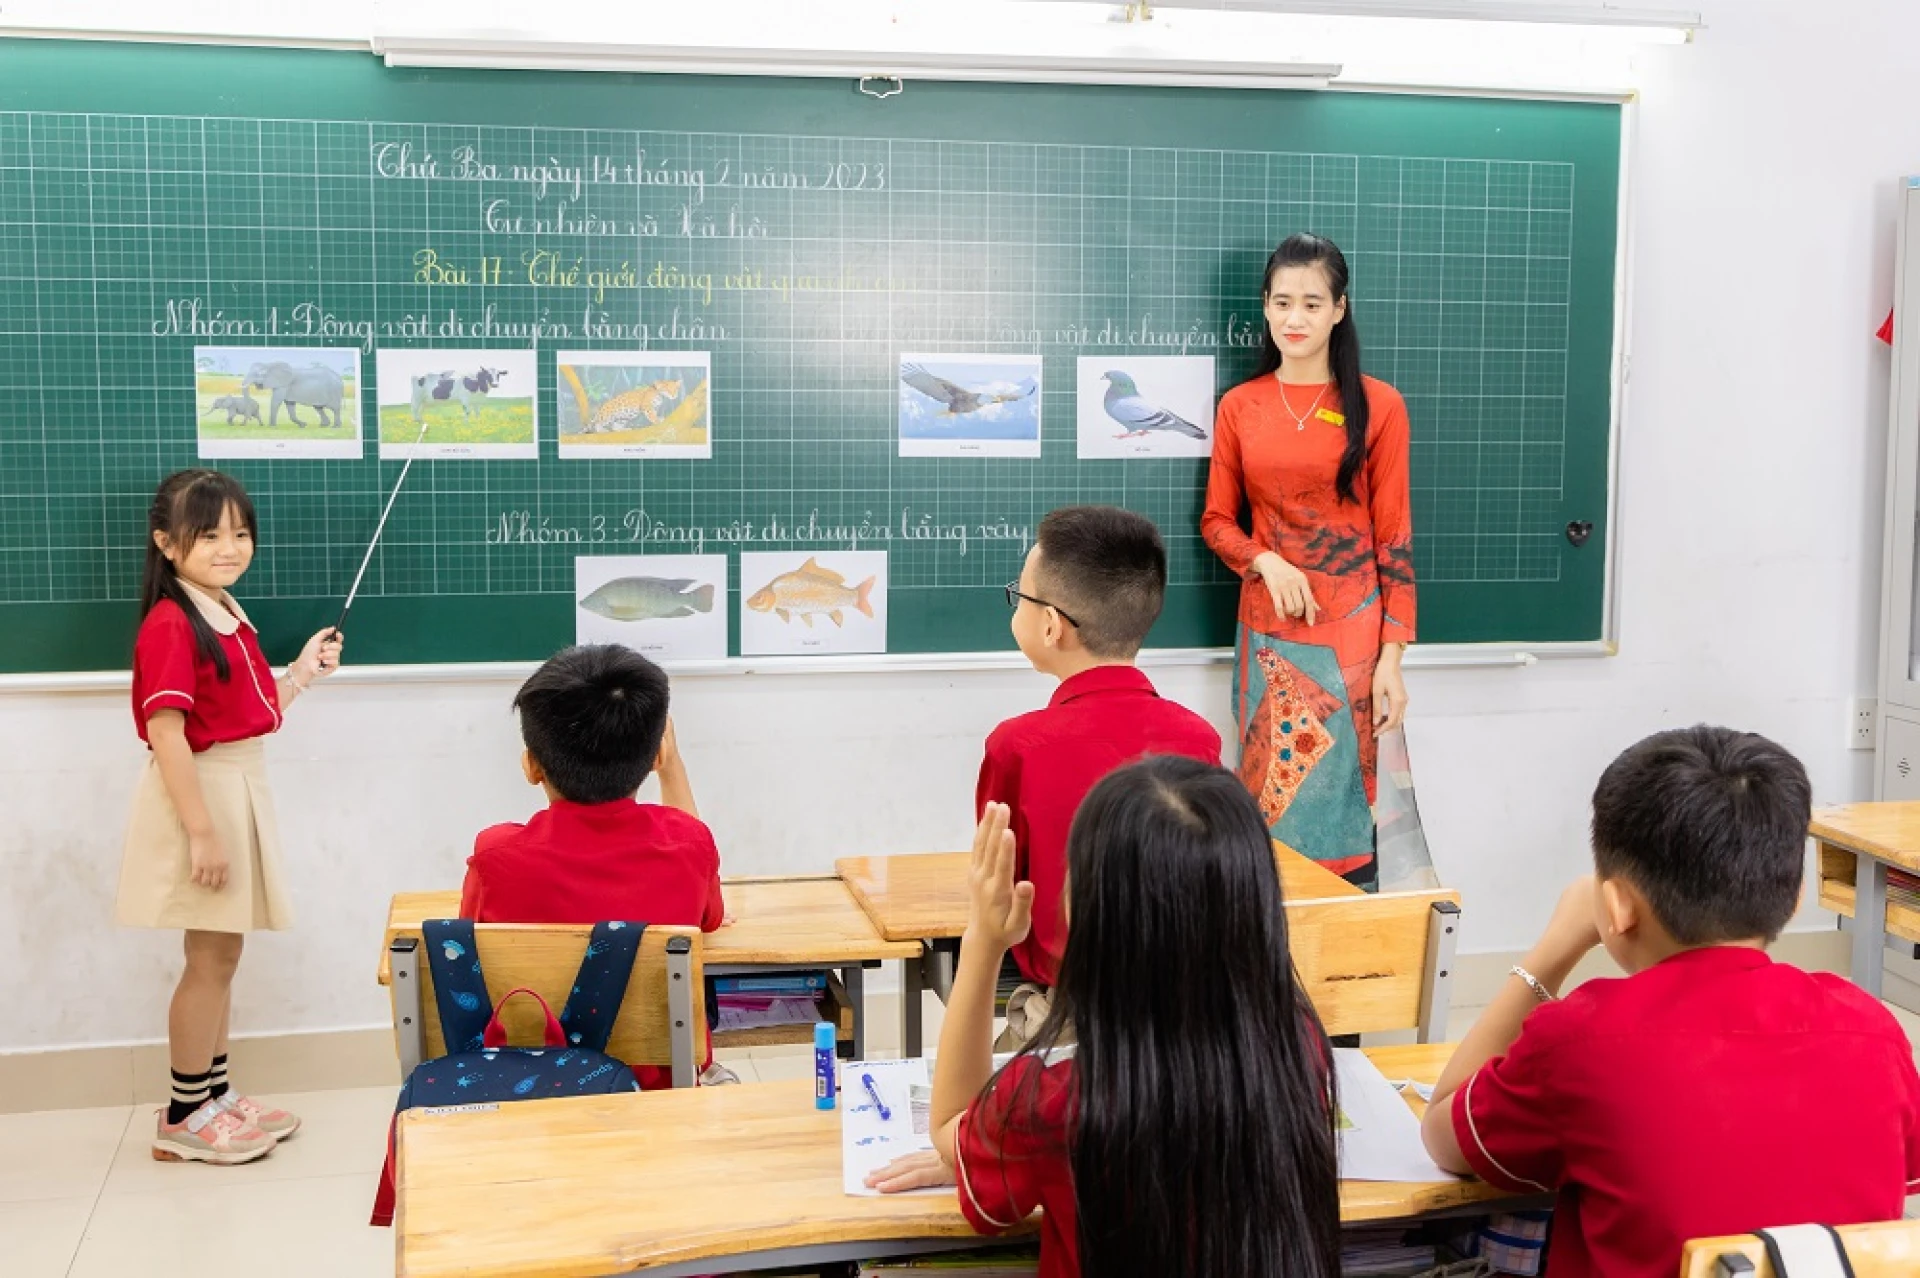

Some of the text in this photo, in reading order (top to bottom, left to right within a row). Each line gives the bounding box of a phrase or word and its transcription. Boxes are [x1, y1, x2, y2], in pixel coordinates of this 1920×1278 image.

[372, 141, 886, 206] Thứ Ba ngày 14 tháng 2 năm 2023
[534, 200, 617, 236] nhiên
[412, 248, 471, 285] Bài
[521, 248, 582, 288] Thế
[586, 260, 639, 304] giới
[646, 261, 712, 306] động
[152, 297, 262, 337] Nhóm
[381, 313, 430, 344] vật
[439, 308, 464, 339] di
[471, 302, 574, 350] chuyển
[582, 302, 650, 351] bằng
[657, 304, 730, 340] chân
[1055, 323, 1090, 351] vật
[1097, 317, 1125, 346] di
[1129, 312, 1220, 356] chuyển
[485, 509, 586, 544] Nhóm
[709, 518, 757, 547] vật
[761, 512, 790, 542] di
[795, 508, 893, 552] chuyển
[900, 506, 967, 557] bằng
[974, 515, 1031, 557] vây
